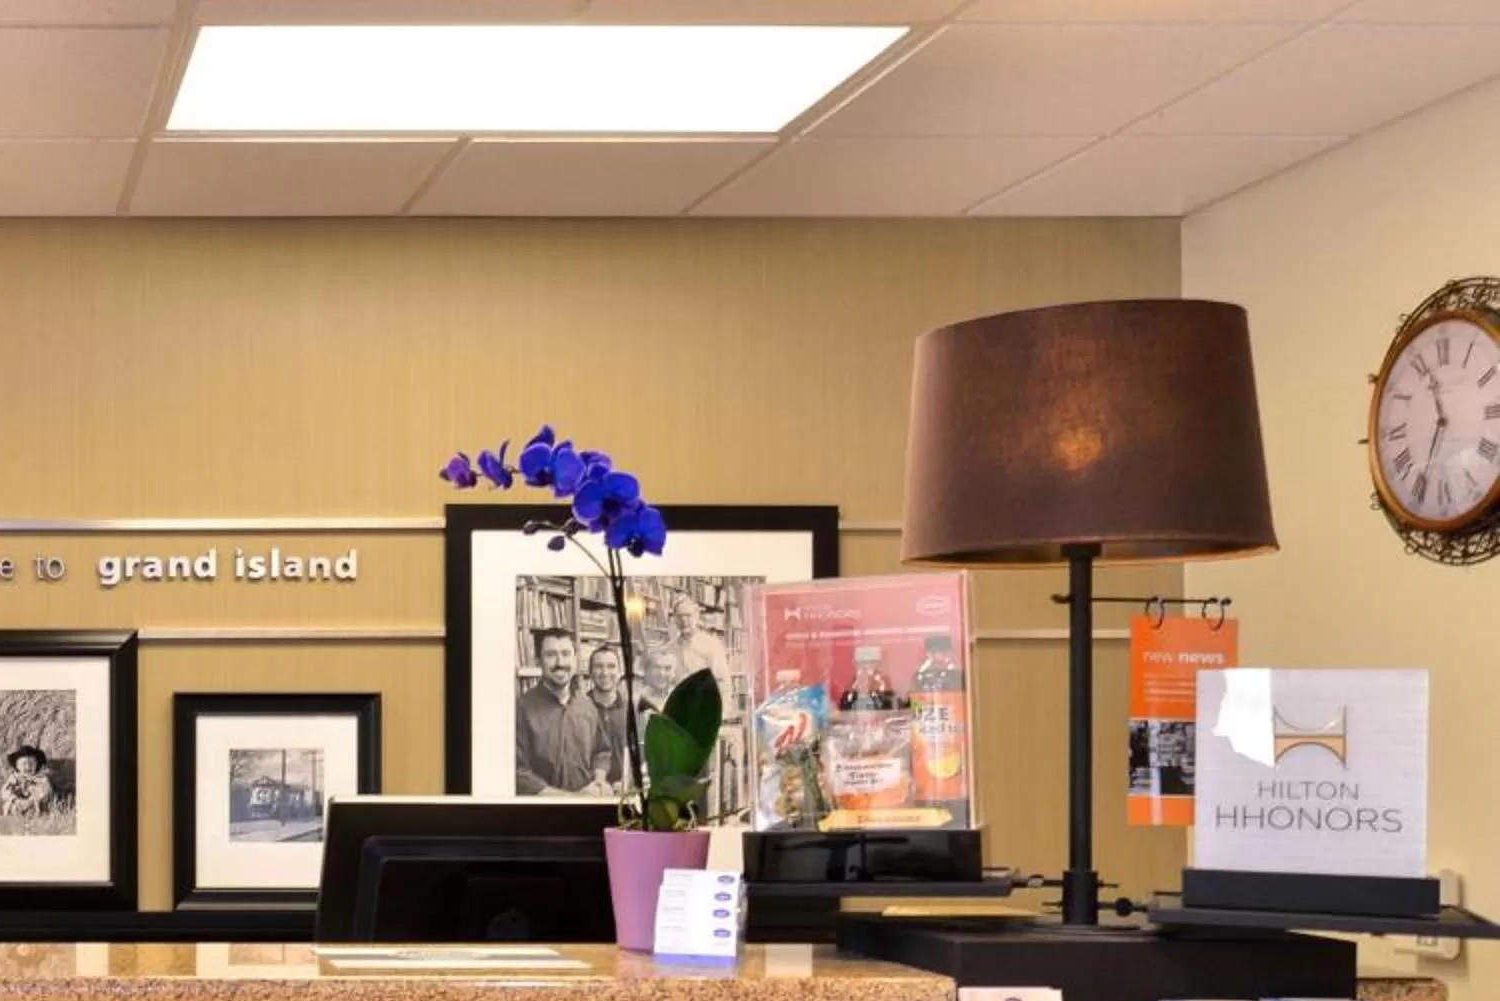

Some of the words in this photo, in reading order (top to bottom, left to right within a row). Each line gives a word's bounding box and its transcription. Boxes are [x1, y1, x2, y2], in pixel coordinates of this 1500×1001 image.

[34, 552, 66, 580] to
[97, 547, 218, 586] grand
[233, 546, 359, 580] island
[1142, 651, 1174, 664] new
[1177, 651, 1226, 665] news
[1257, 779, 1360, 801] HILTON
[1215, 804, 1404, 833] HHONORS
